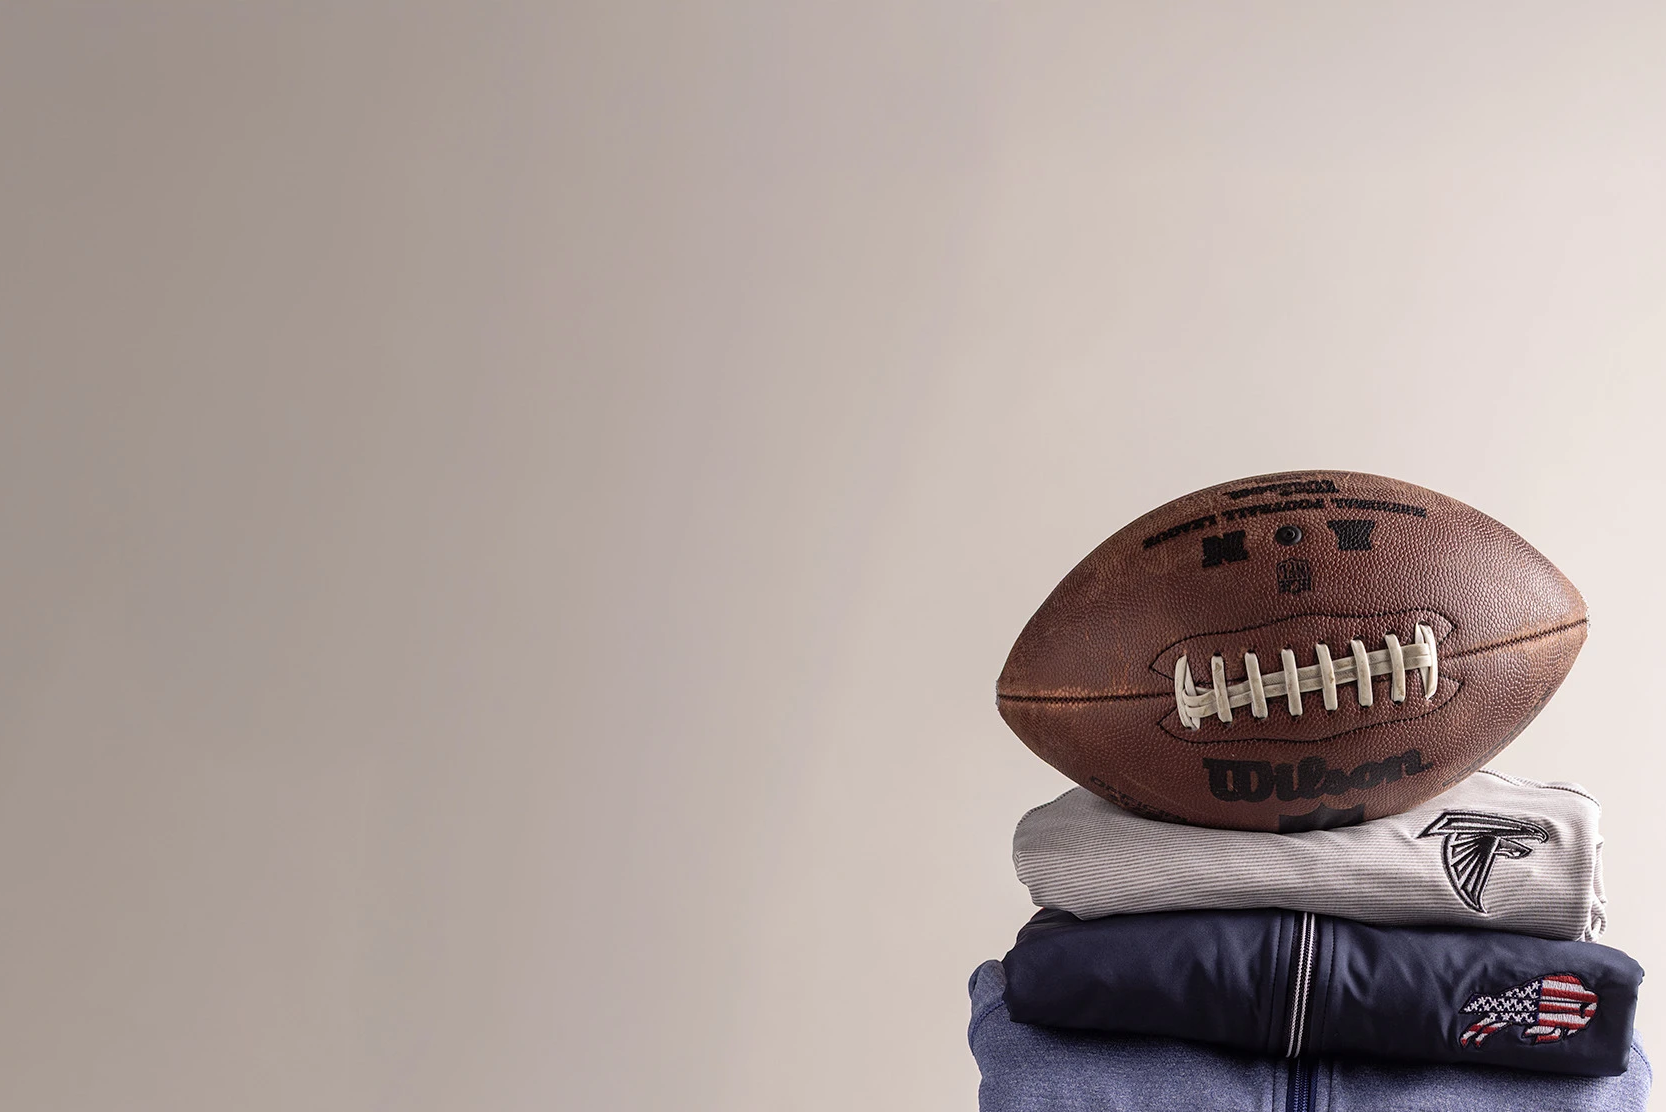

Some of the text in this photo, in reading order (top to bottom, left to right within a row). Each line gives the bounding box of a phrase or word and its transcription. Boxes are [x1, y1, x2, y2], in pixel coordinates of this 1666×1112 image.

[1142, 498, 1426, 549] NATIONAL FOOTBALL LEAGUE
[1202, 748, 1433, 802] Wilson
